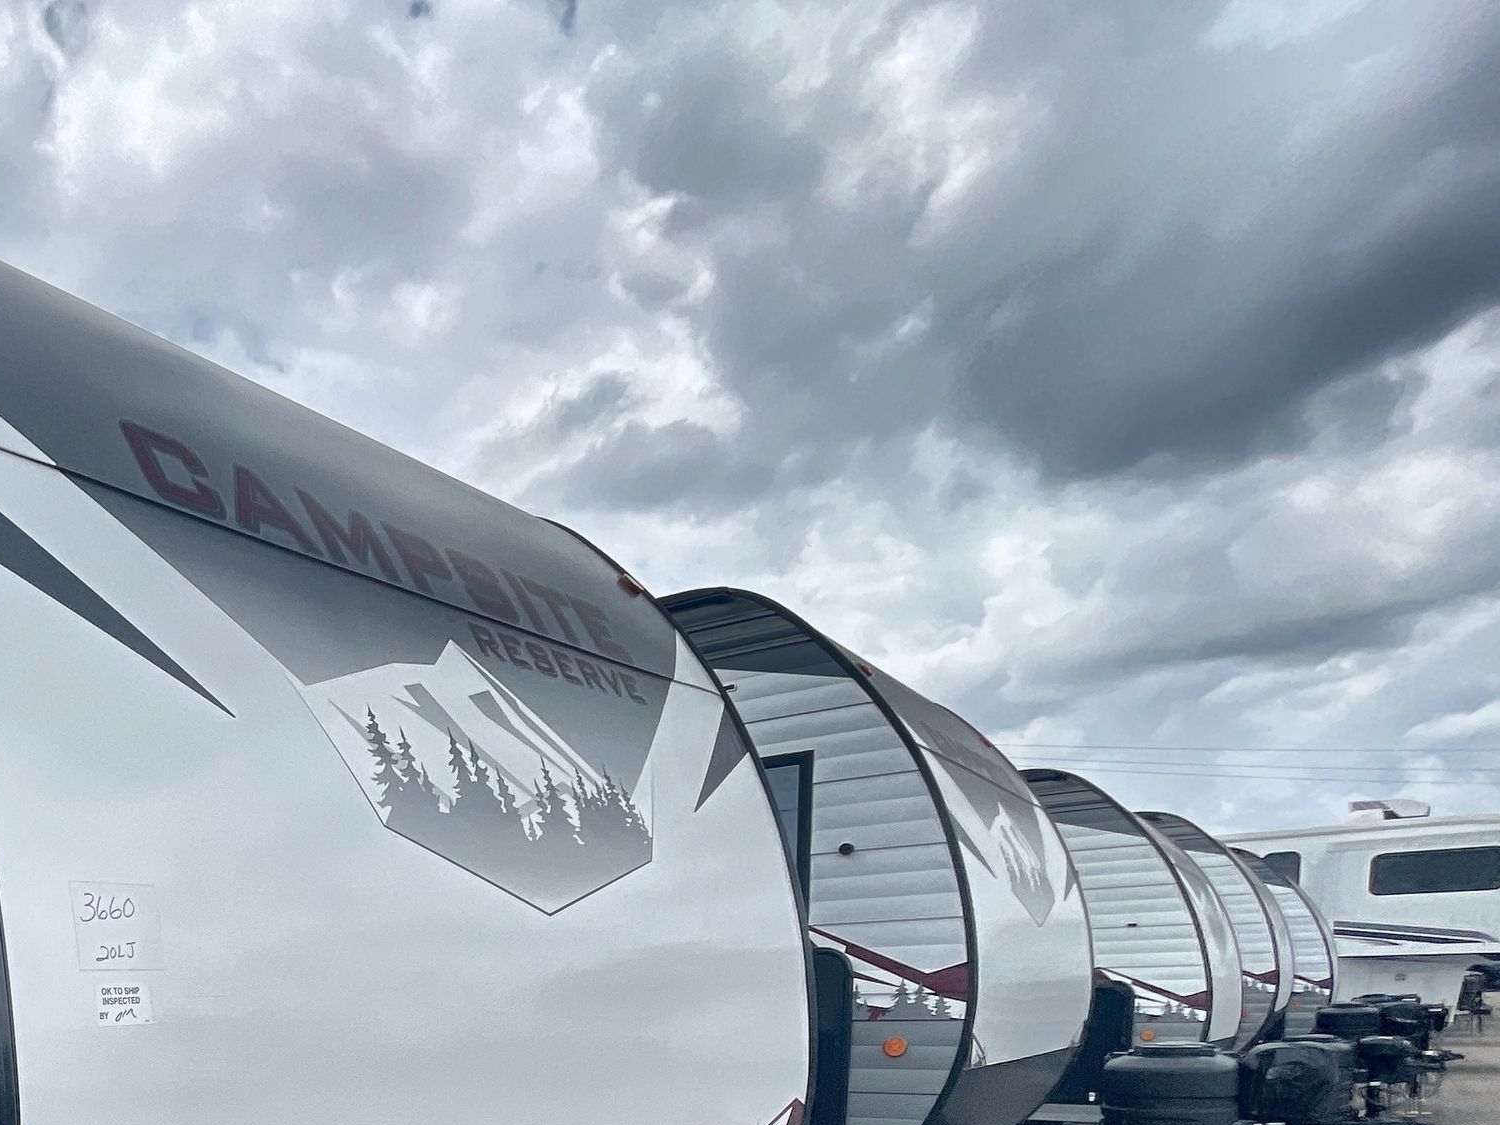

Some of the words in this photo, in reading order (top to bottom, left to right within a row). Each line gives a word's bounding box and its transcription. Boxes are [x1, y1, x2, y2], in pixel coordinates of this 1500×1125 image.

[118, 418, 634, 663] CAMPSITE
[467, 622, 647, 704] RESERVE
[80, 892, 135, 923] 3660
[101, 987, 111, 996] OK
[113, 987, 123, 995] TO
[124, 986, 140, 995] SHIP
[102, 996, 141, 1006] INSPECTED
[99, 1011, 109, 1020] BY
